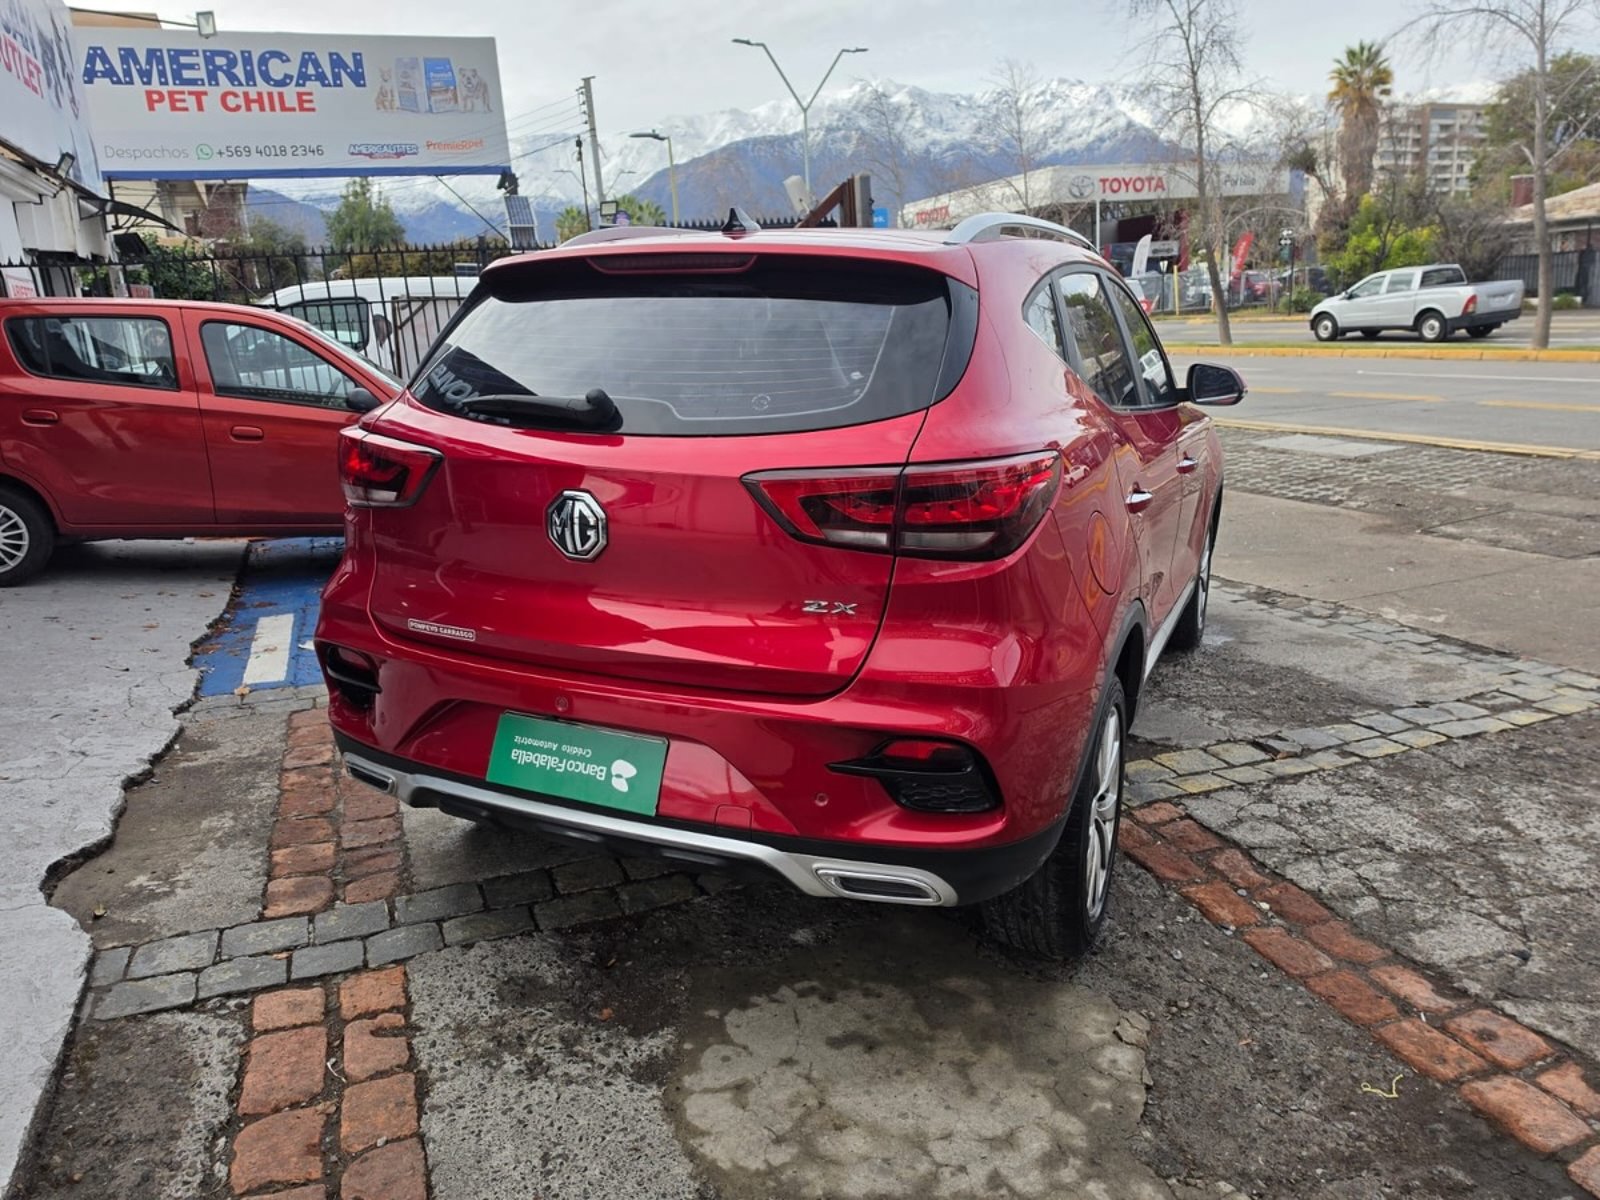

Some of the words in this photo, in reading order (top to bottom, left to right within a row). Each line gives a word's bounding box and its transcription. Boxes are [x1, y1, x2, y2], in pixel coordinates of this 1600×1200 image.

[0, 32, 44, 99] UTLET
[82, 46, 366, 87] AMERICAN
[145, 90, 208, 112] PET
[219, 90, 316, 113] CHILE
[104, 145, 190, 161] Despachos
[216, 144, 251, 158] +569
[255, 144, 288, 157] 4018
[291, 144, 325, 157] 2346
[1098, 176, 1166, 193] TOYOTA
[551, 500, 598, 553] MG
[802, 600, 858, 615] ZX
[440, 627, 474, 638] CARRASCO
[514, 735, 558, 752] Automotriz
